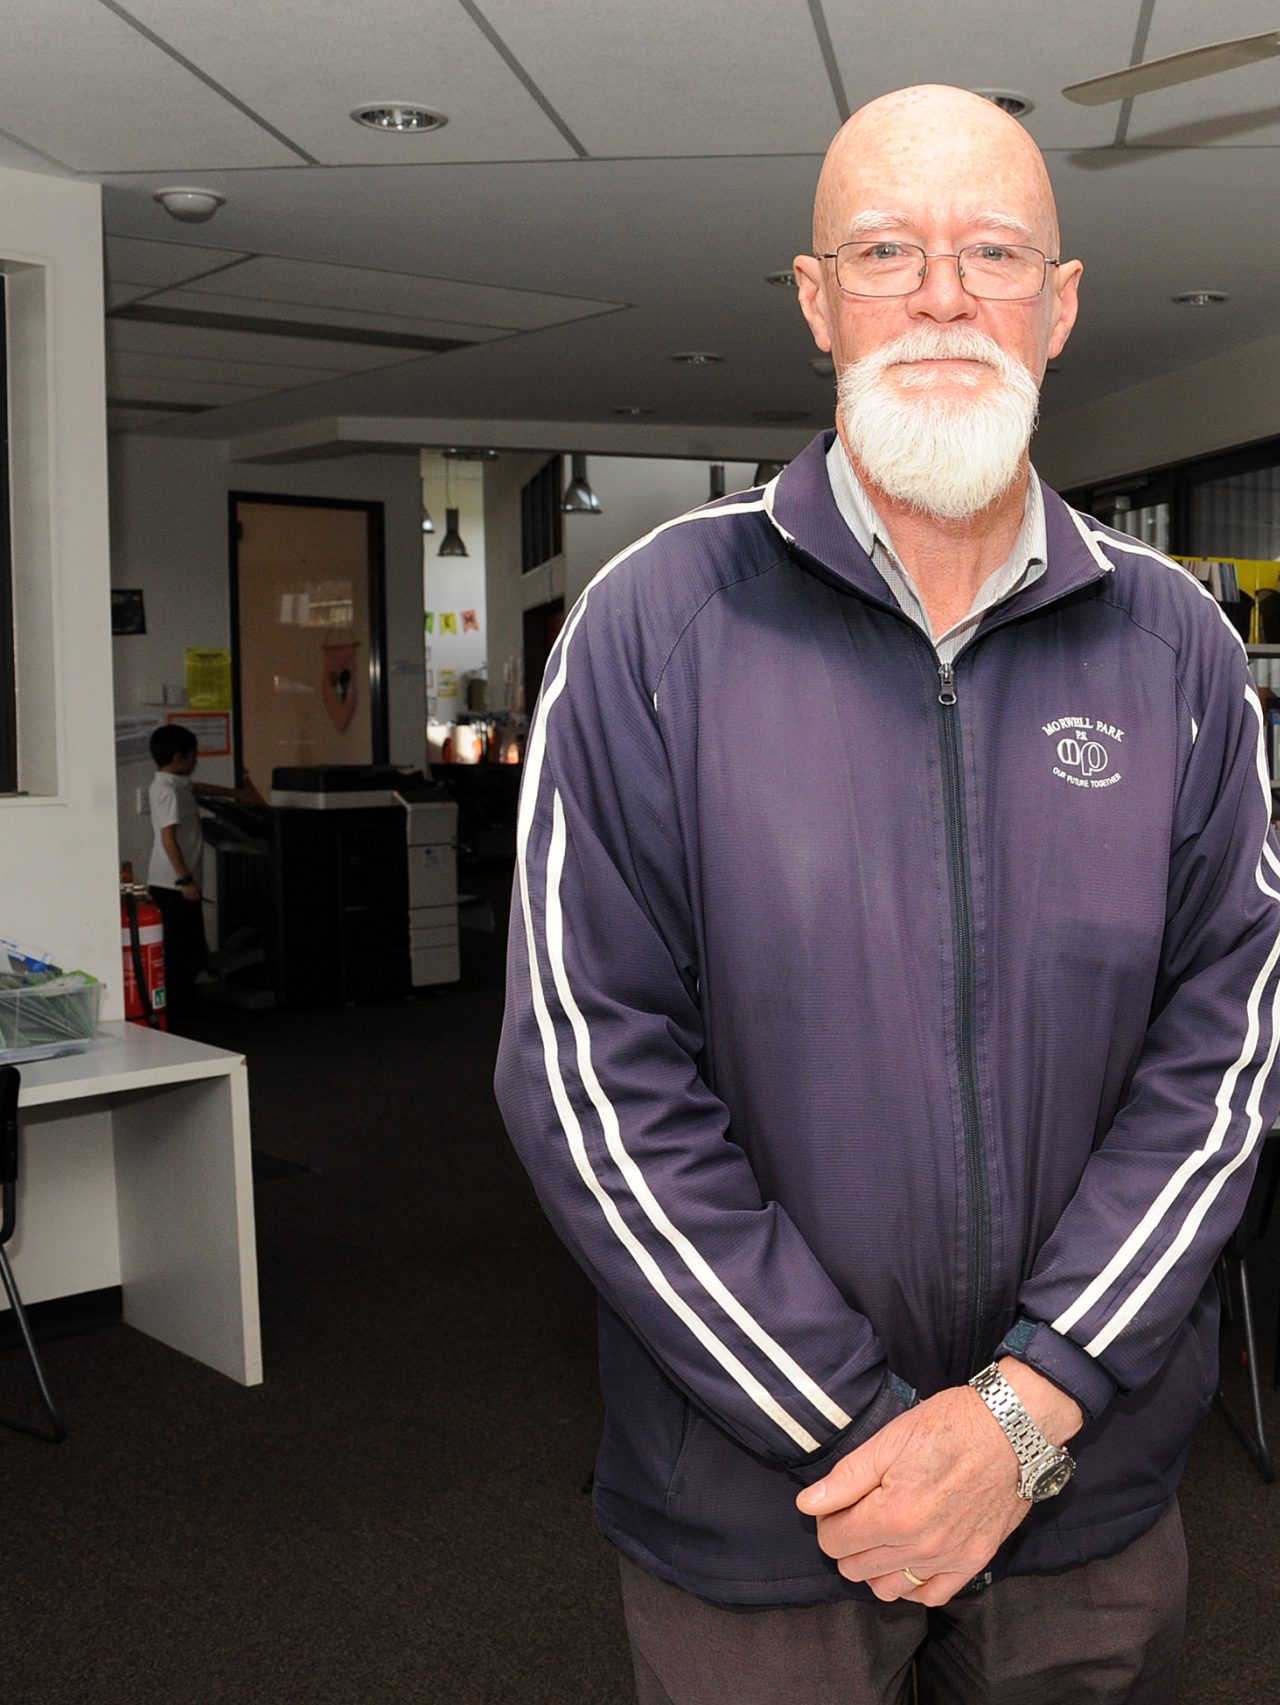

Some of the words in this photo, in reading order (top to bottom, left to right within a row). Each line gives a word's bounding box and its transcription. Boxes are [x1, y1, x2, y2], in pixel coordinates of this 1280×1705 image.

[1042, 716, 1093, 736] MORWELL
[1096, 720, 1125, 742] PARK
[1053, 767, 1066, 779] OUR
[1067, 774, 1089, 788] FUTURE
[1090, 773, 1122, 788] TOGETHER
